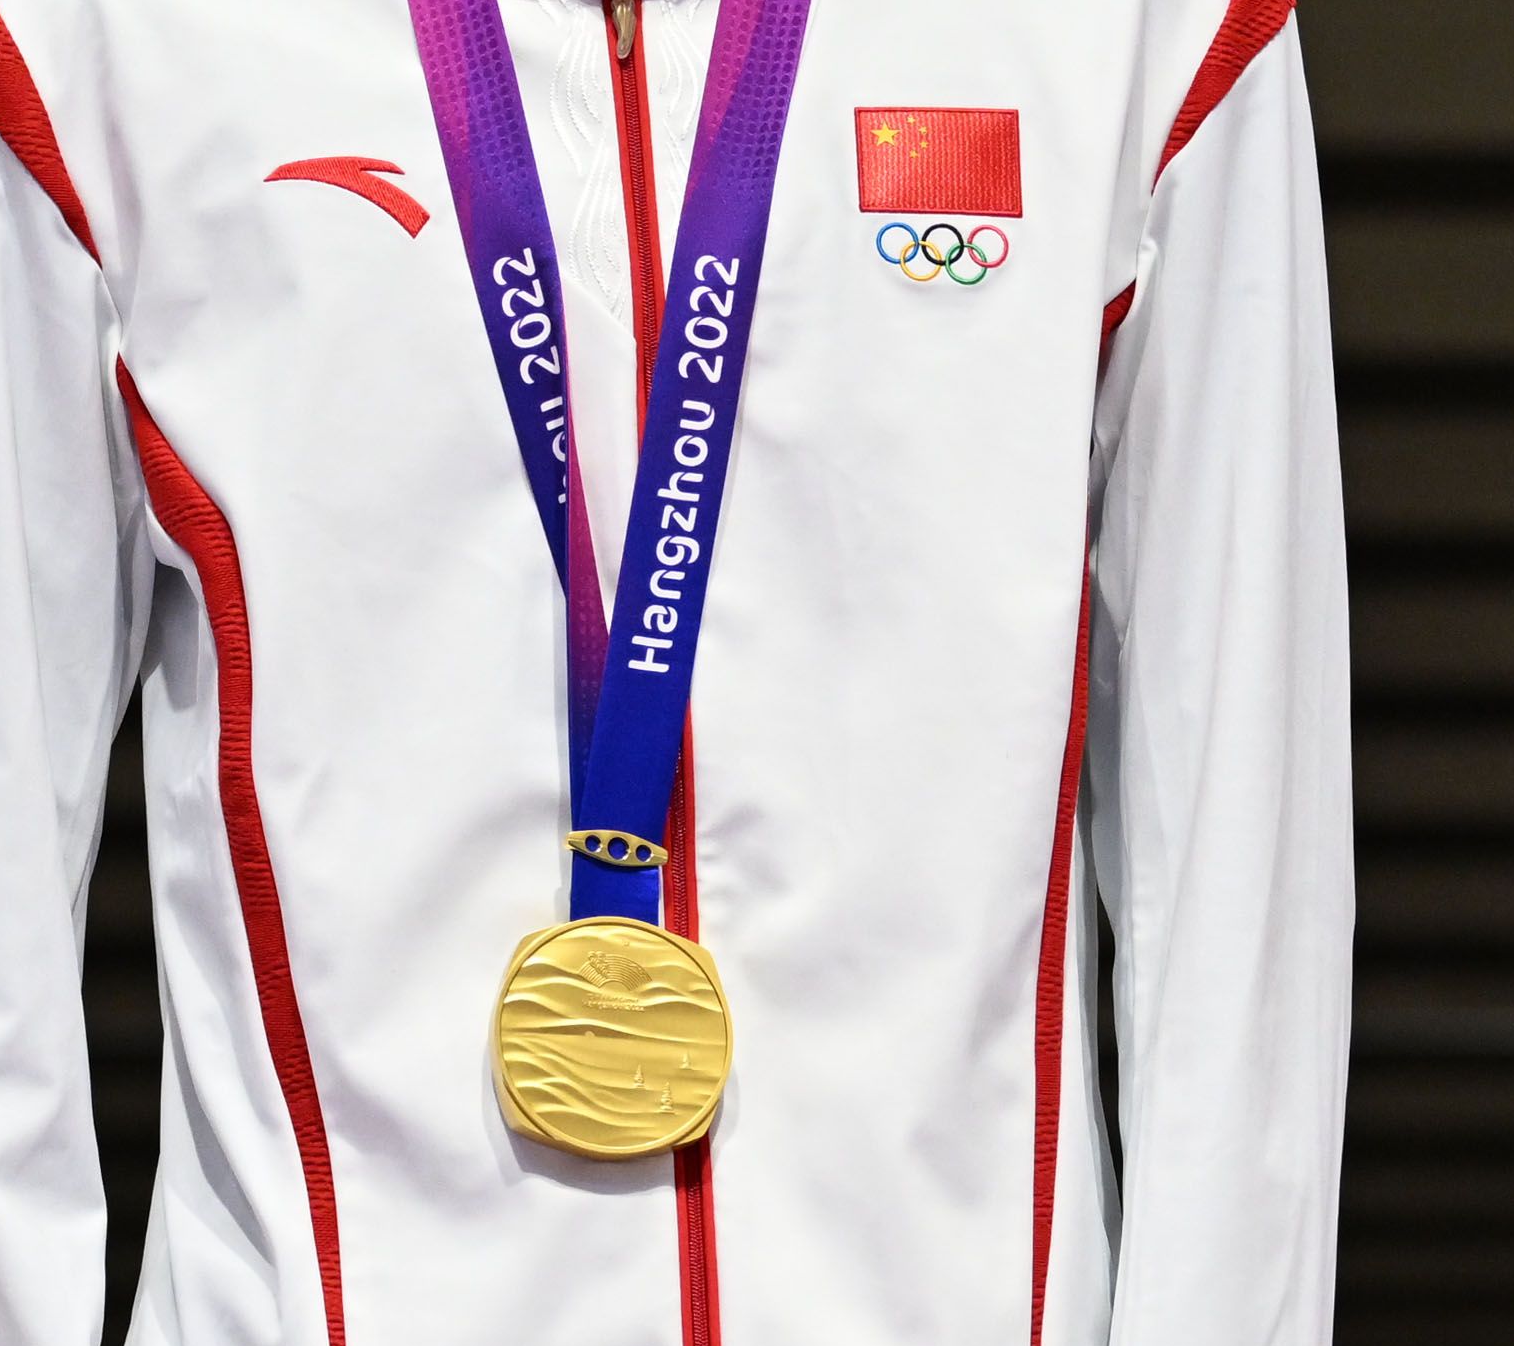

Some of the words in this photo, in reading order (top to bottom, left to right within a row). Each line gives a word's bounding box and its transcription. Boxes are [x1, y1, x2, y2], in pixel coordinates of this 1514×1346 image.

[493, 247, 562, 385] 2022
[628, 399, 715, 673] Hangzhou
[679, 255, 740, 384] 2022
